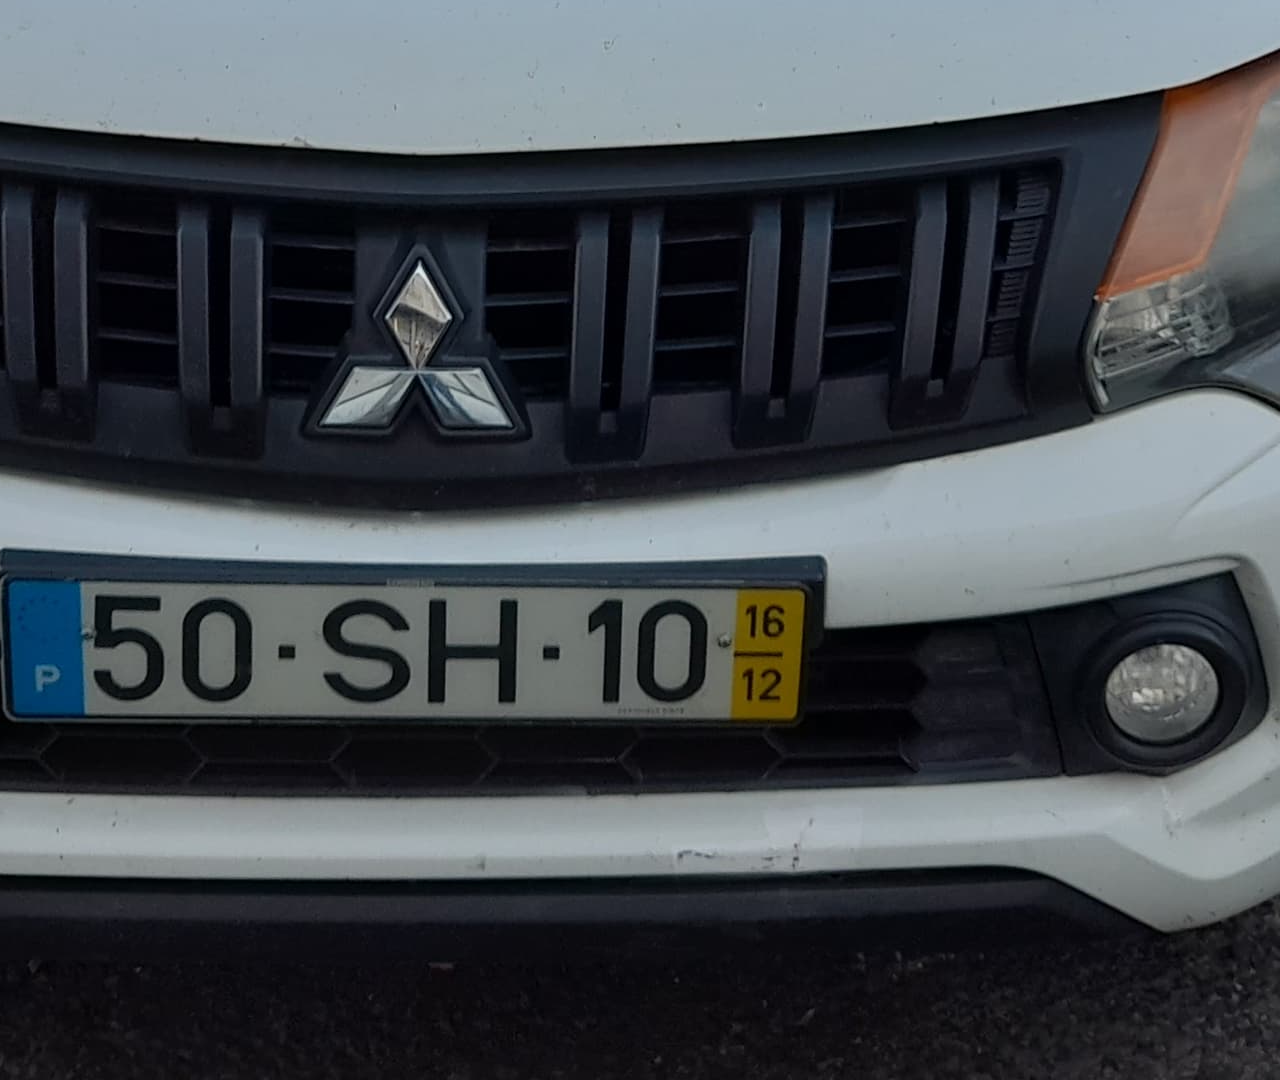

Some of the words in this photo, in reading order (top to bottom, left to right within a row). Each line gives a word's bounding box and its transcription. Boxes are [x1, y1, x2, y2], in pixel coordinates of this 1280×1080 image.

[745, 603, 785, 639] 16
[34, 664, 61, 692] P
[742, 667, 782, 702] 12
